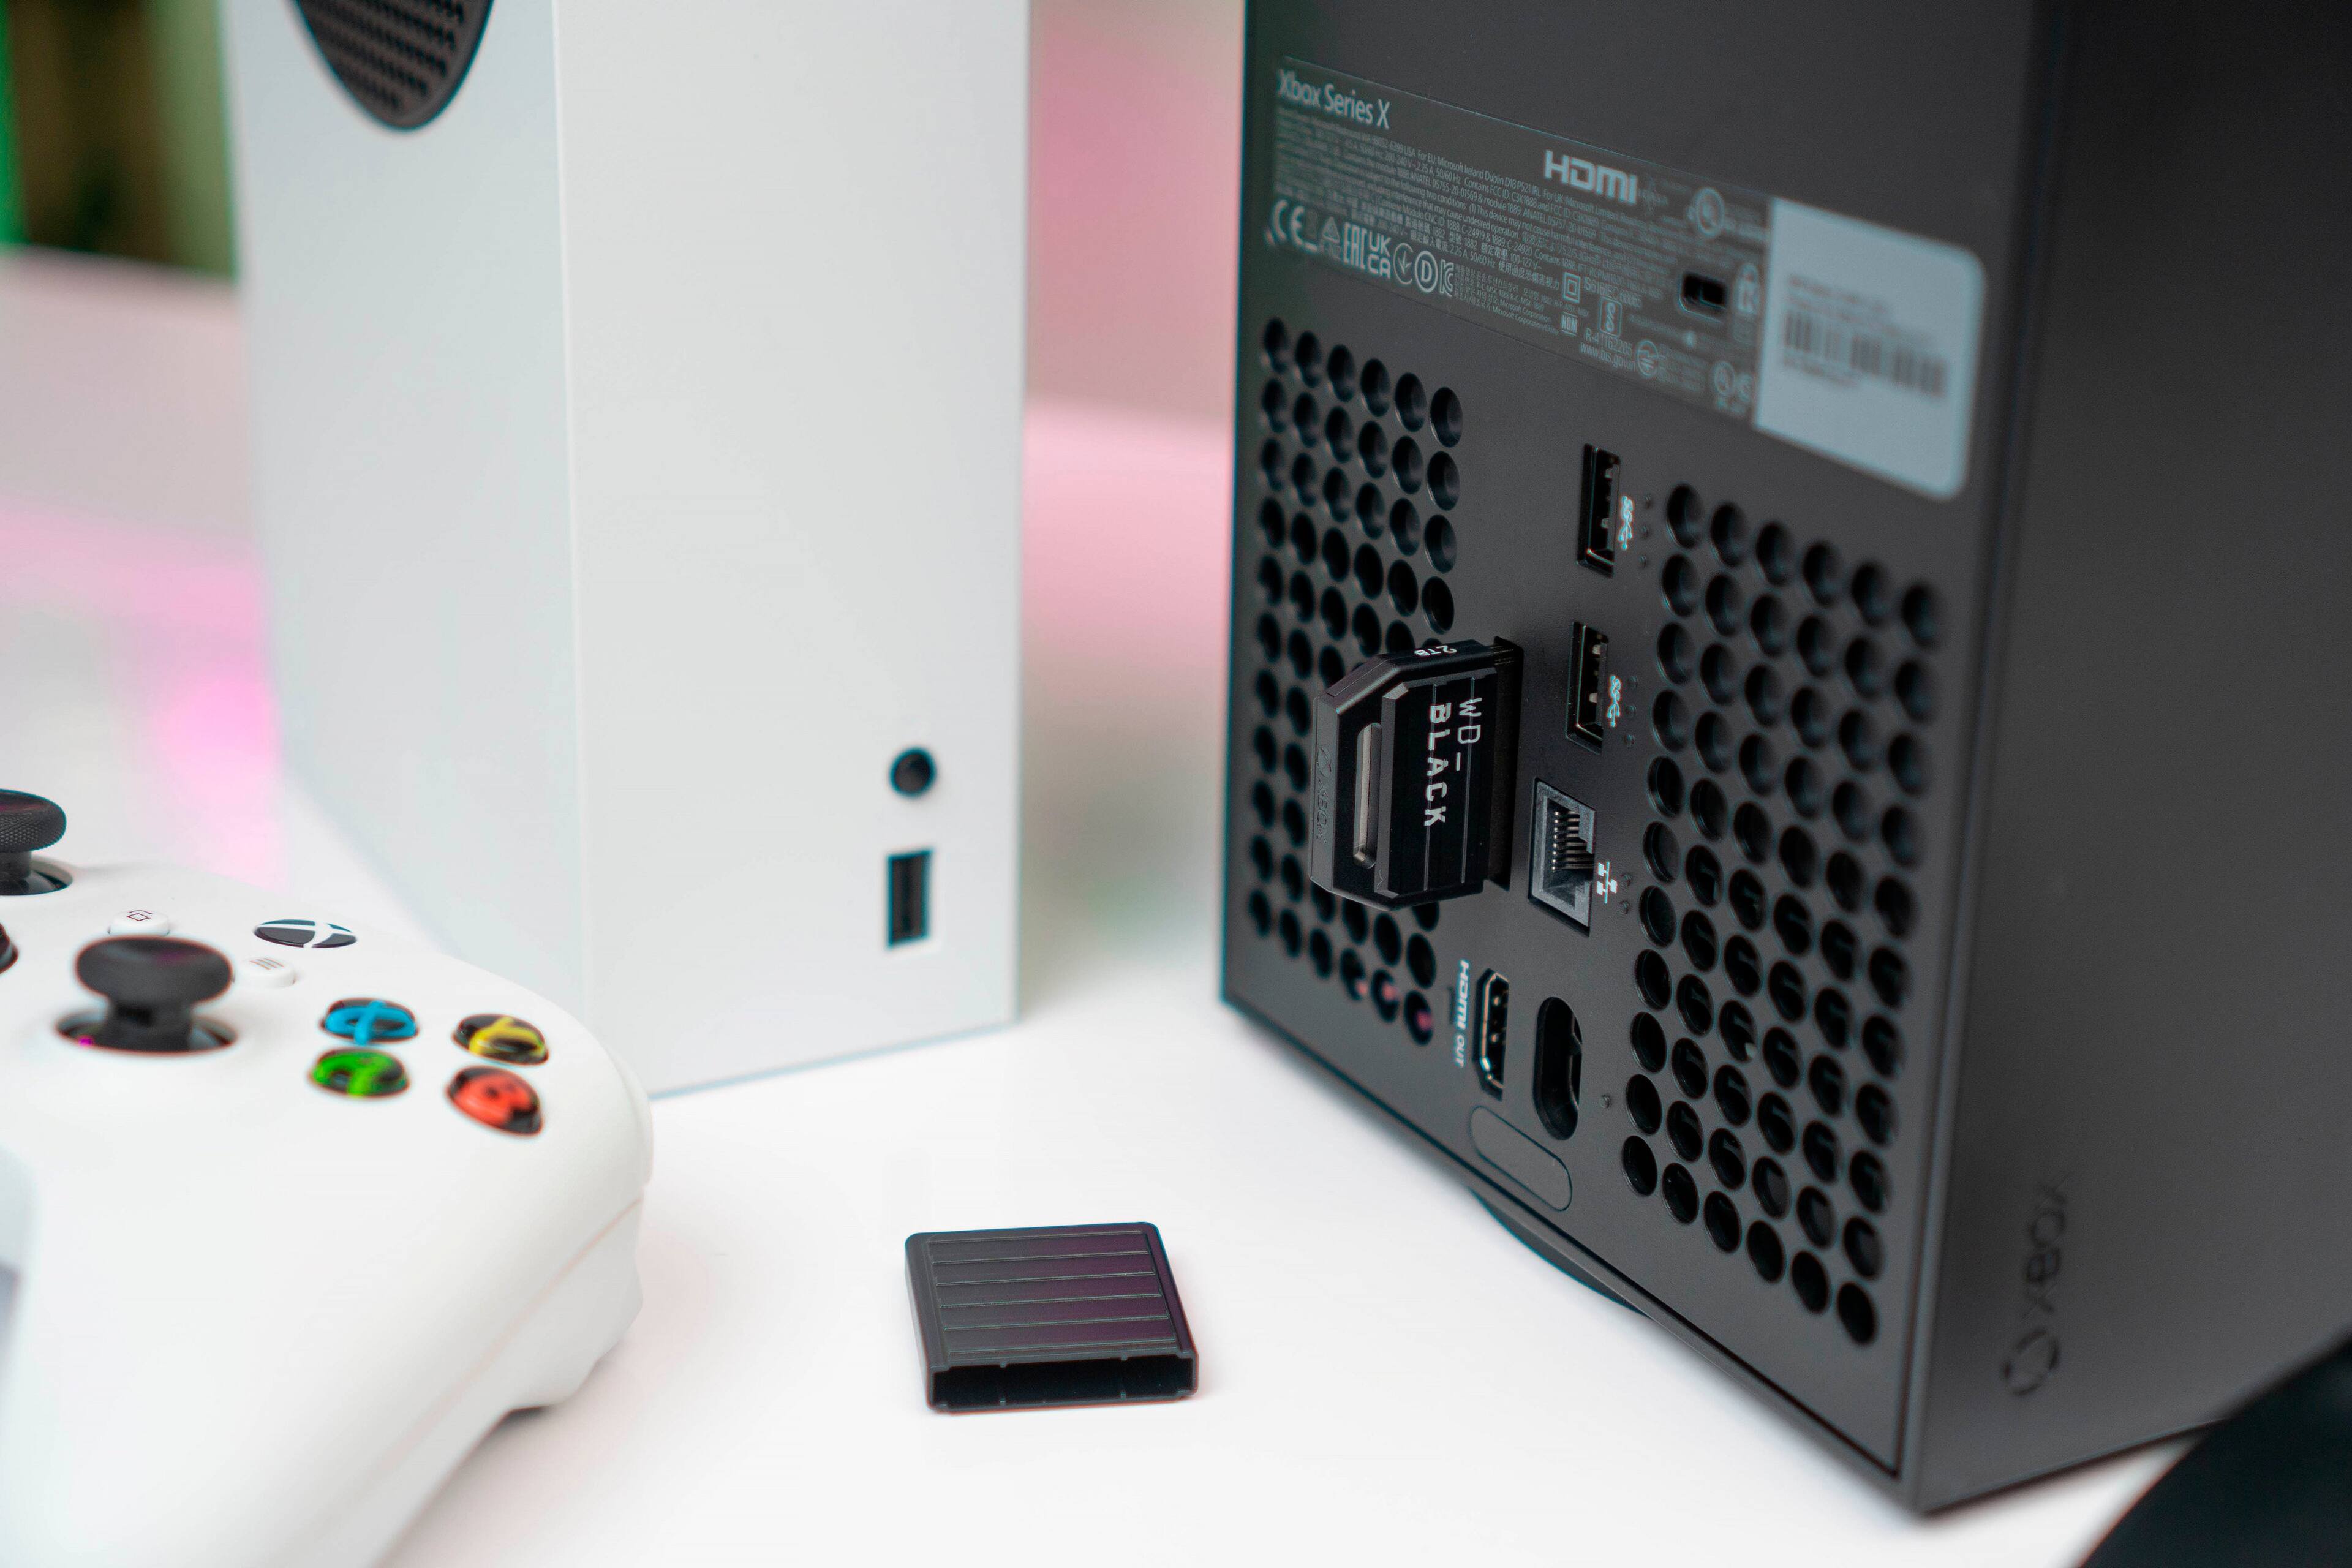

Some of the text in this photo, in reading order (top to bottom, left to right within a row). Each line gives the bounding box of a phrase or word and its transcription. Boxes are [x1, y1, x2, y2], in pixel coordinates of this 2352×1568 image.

[1278, 69, 1321, 108] Xbox
[1324, 83, 1373, 124] Series
[1377, 99, 1390, 129] X
[1436, 167, 1453, 182] 50/60
[1464, 176, 1490, 194] Contains
[1490, 184, 1502, 197] FCC
[1437, 156, 1464, 172] Microsoft
[1464, 164, 1484, 179] Ireland
[1484, 170, 1504, 185] Dublin
[1545, 150, 1637, 204] HDMI
[1476, 205, 1488, 217] This
[1488, 209, 1508, 224] device
[1367, 230, 1392, 257] UK
[1366, 252, 1392, 280] CA
[1469, 251, 1487, 266] 50/60
[1561, 313, 1578, 334] NOM
[1414, 645, 1457, 656] 2TB
[1424, 702, 1452, 827] BLACK
[1456, 960, 1469, 1030] HDMI
[1455, 1035, 1465, 1068] OUT
